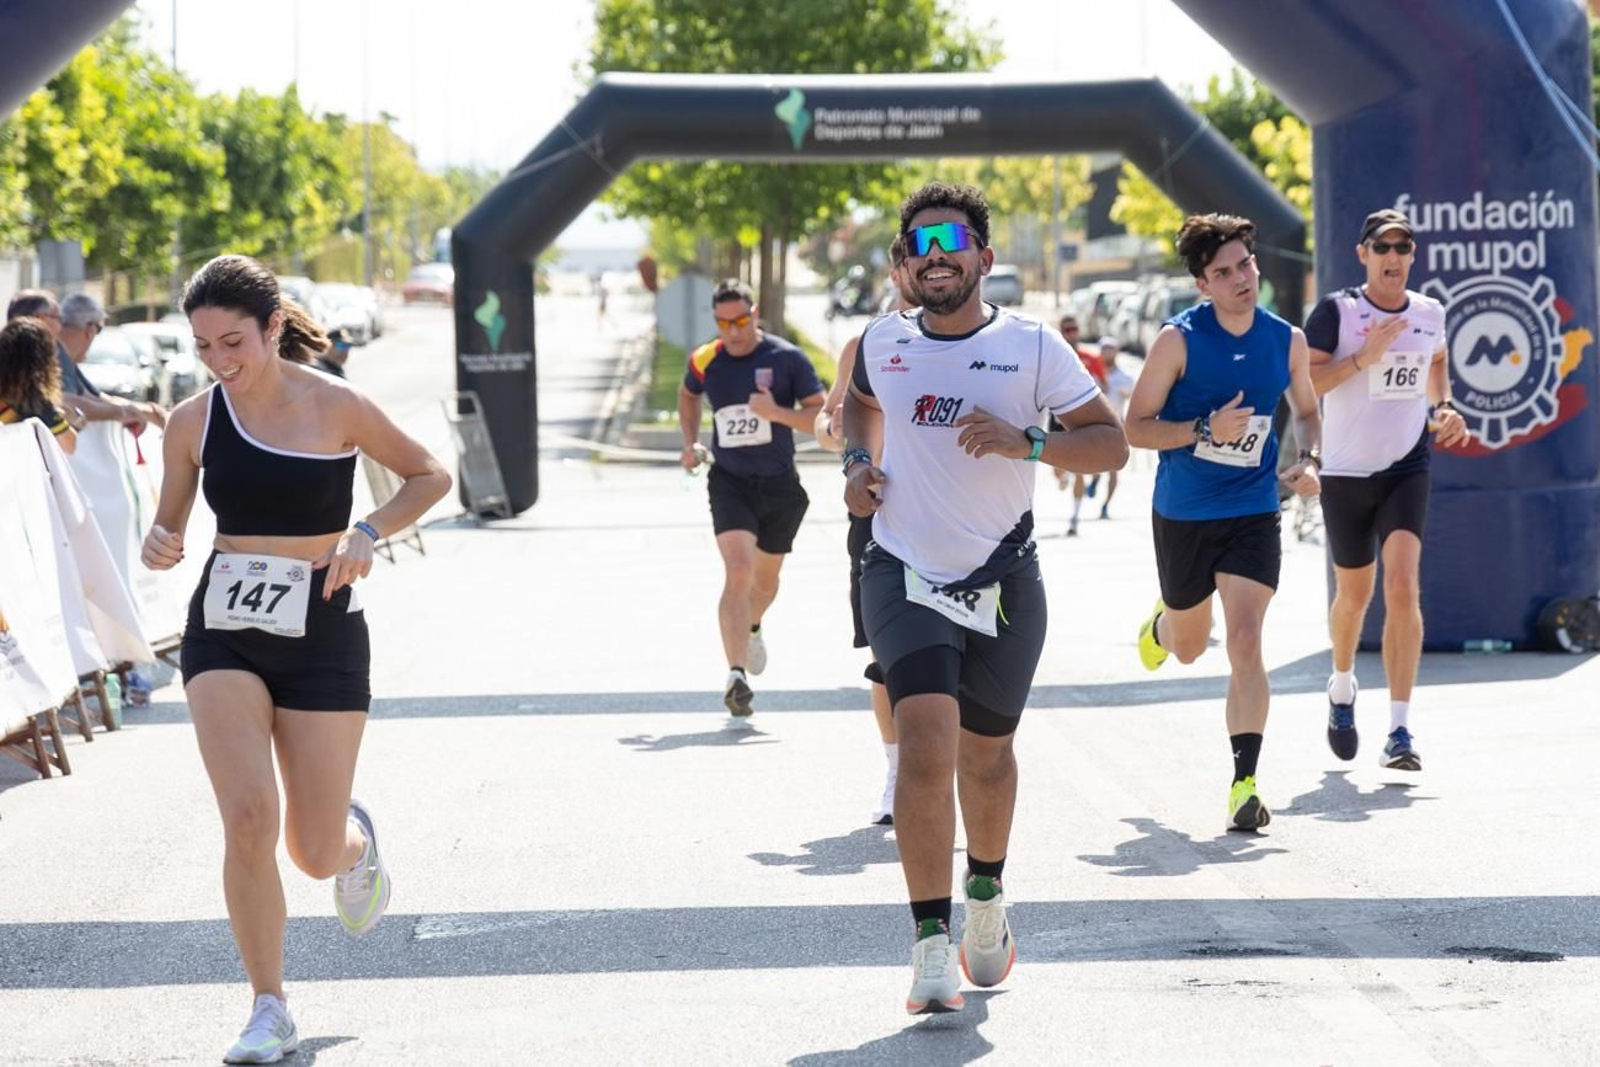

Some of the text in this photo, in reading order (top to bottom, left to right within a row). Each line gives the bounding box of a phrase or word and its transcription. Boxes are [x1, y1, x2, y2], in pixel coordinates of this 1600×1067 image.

[815, 106, 982, 125] Patronato Municipal de
[815, 124, 882, 141] Deportes
[884, 124, 905, 138] de
[1394, 190, 1574, 233] fundación
[1428, 230, 1546, 277] mupol
[990, 363, 1019, 373] mupol
[1383, 367, 1419, 386] 166
[1465, 390, 1522, 410] POLICÍA
[727, 418, 759, 436] 229
[1211, 433, 1259, 453] 48
[226, 580, 292, 614] 147
